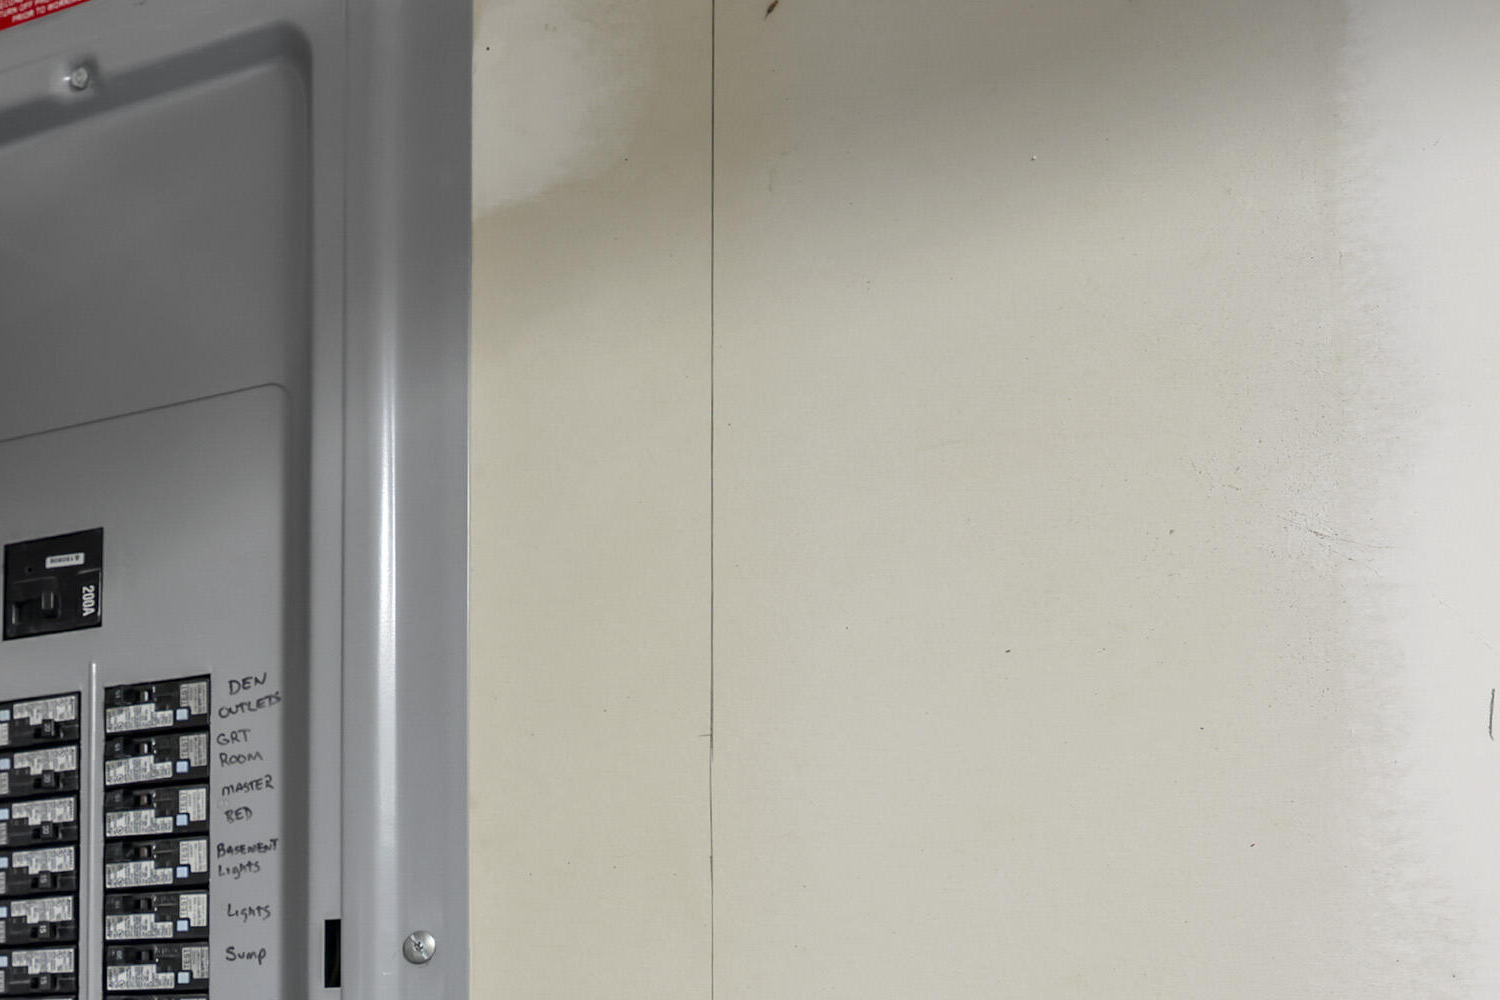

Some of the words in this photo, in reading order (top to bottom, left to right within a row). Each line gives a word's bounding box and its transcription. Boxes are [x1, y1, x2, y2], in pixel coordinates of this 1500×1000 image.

[82, 585, 96, 617] 200A
[227, 672, 267, 696] DEN
[218, 691, 282, 719] OUTLETS
[216, 729, 251, 746] GRT
[219, 751, 264, 768] ROOM
[221, 774, 275, 797] MASTER
[224, 805, 253, 824] BED
[217, 837, 279, 859] BASEMENT
[218, 860, 261, 880] Lights
[227, 903, 272, 923] Lights
[225, 946, 267, 966] Sump
